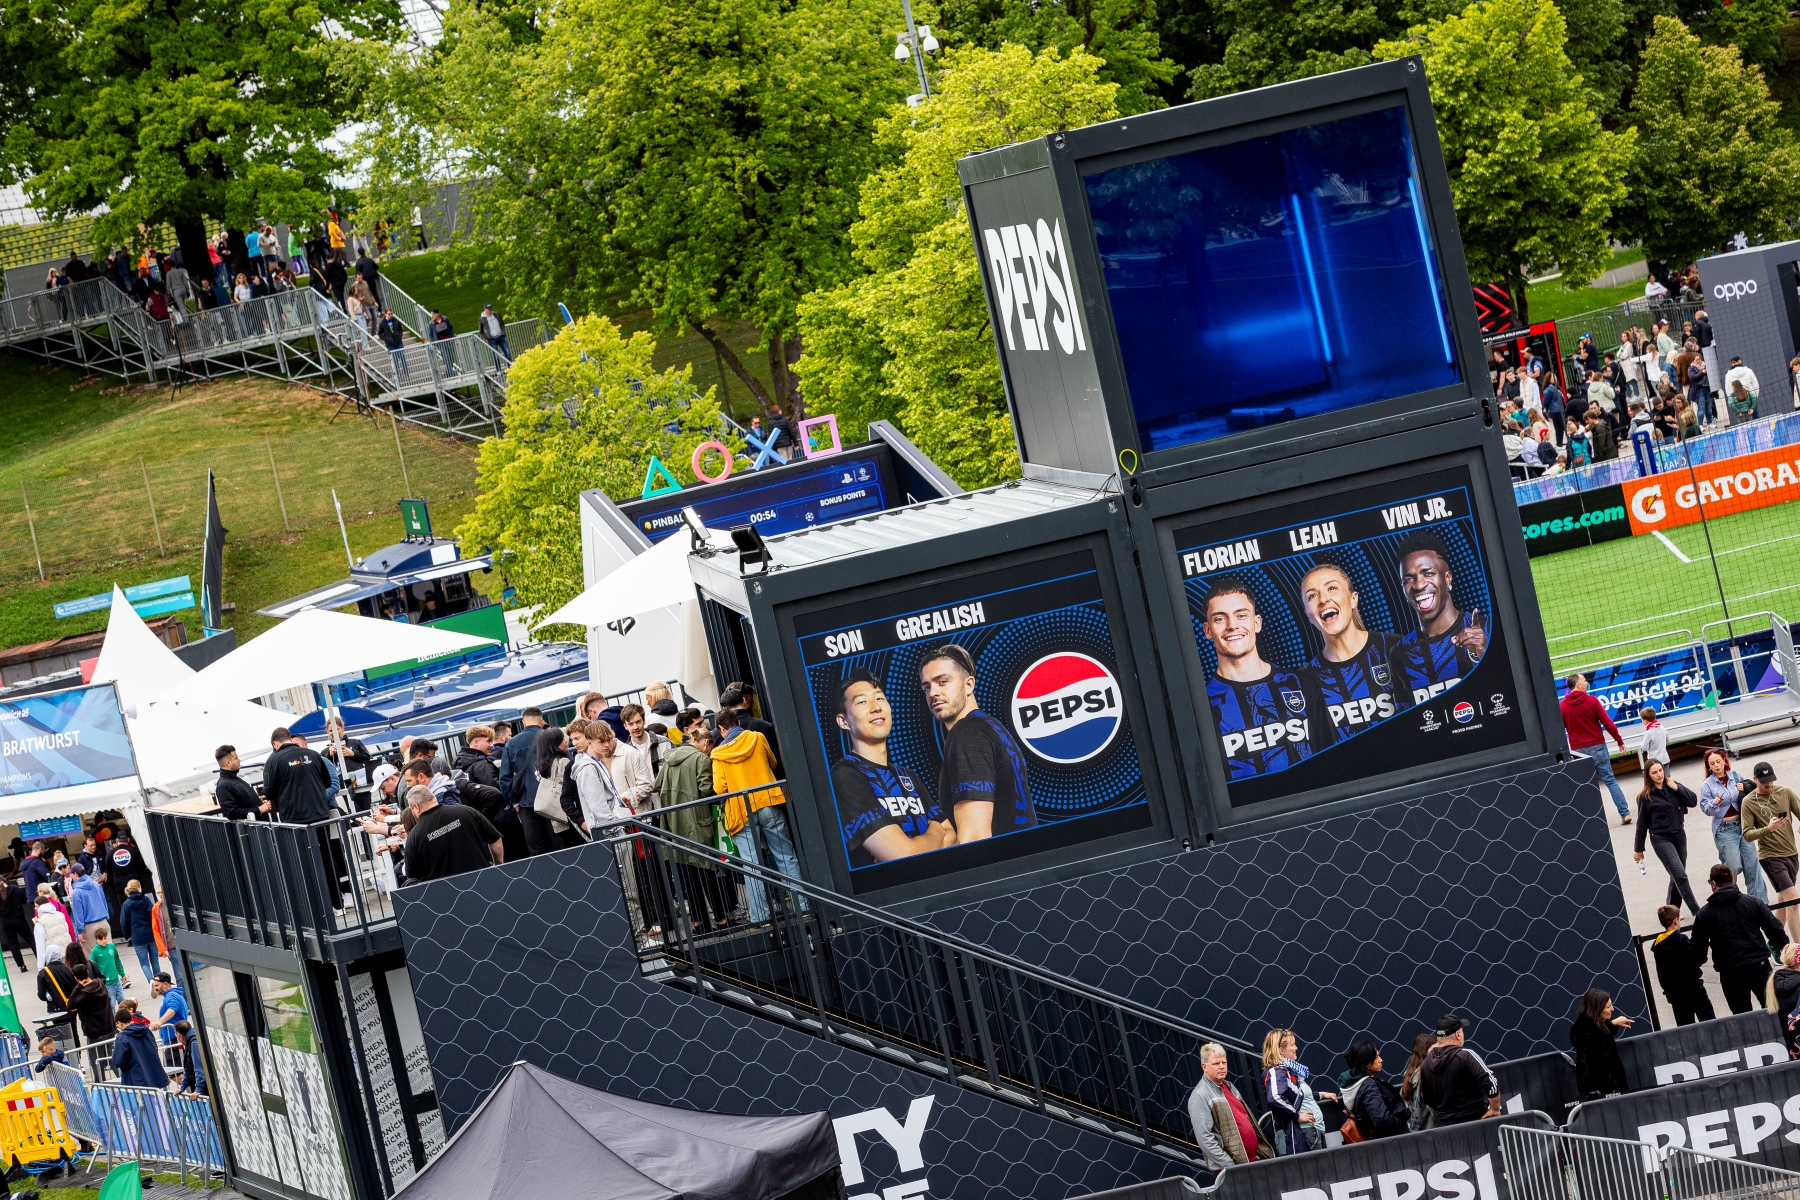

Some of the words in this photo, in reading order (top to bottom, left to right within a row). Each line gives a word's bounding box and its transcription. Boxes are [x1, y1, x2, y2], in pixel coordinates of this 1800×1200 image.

[984, 217, 1087, 355] PEPSI
[1713, 279, 1758, 302] oppo
[820, 493, 842, 507] BONUS
[842, 489, 866, 503] POINTS
[1675, 461, 1800, 510] GATORA
[652, 513, 685, 529] PINBAL
[750, 509, 777, 524] 00:54
[1183, 538, 1261, 576] FLORIAN
[1289, 521, 1339, 552] LEAH
[1382, 502, 1420, 531] VINI
[1422, 497, 1454, 522] JR.
[824, 630, 865, 658] SON
[895, 602, 986, 642] GREALISH
[1018, 686, 1117, 729] PEPSI
[1327, 692, 1397, 728] PEPS
[1454, 708, 1473, 717] PEPSI
[1625, 700, 1680, 720] FIAL
[3, 730, 80, 757] BRATWURST
[1281, 1152, 1499, 1200] PSI
